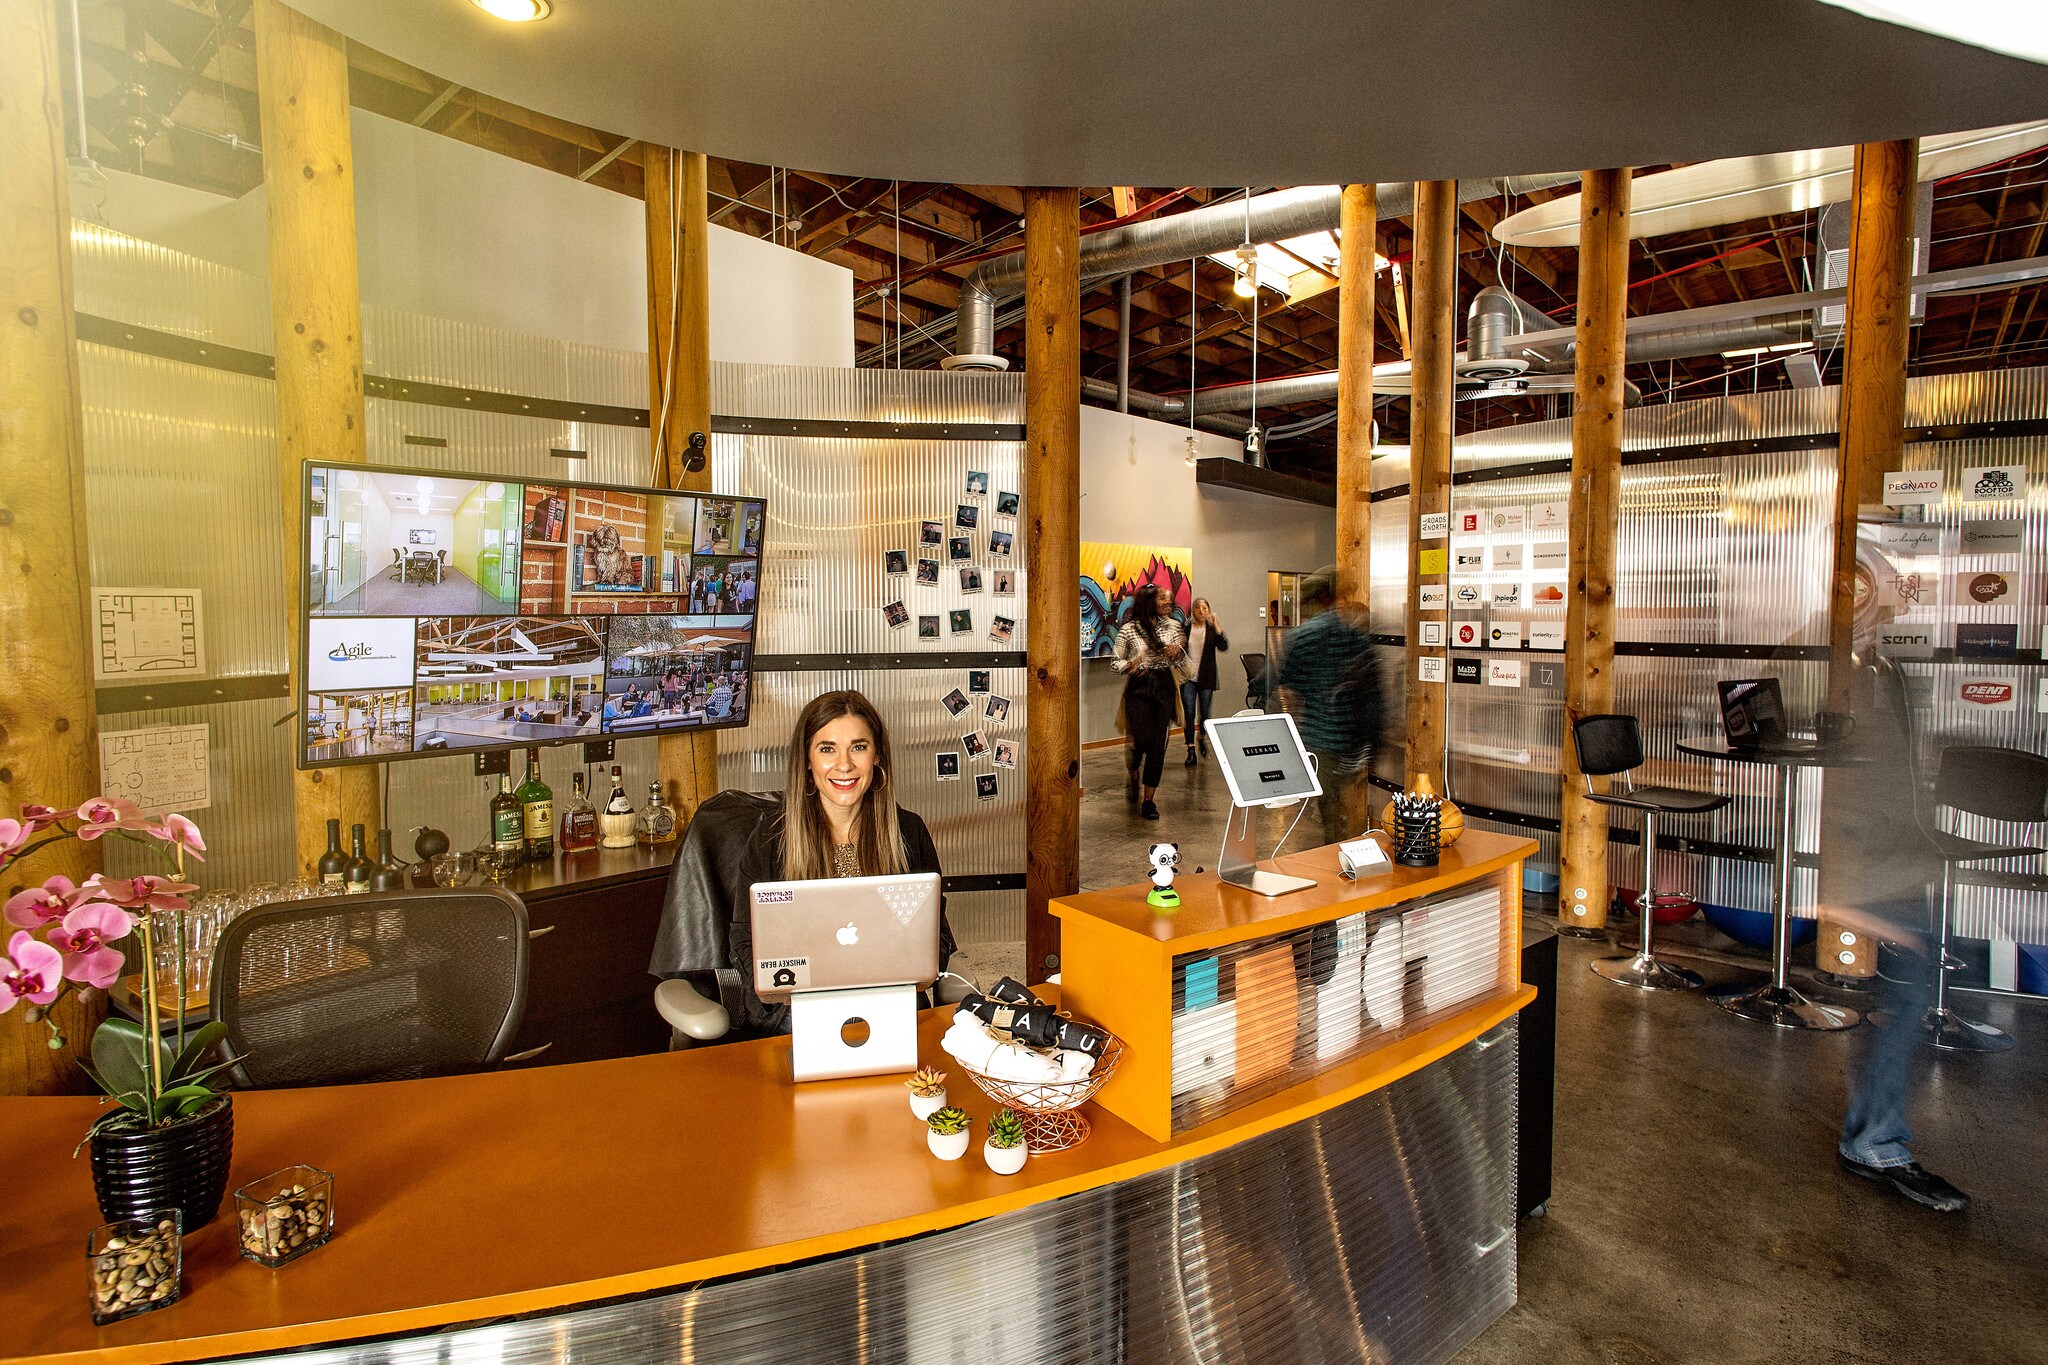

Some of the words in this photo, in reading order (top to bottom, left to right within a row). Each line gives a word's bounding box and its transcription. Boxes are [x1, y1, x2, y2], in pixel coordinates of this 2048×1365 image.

[1888, 480, 1938, 491] PEGNATO
[1974, 487, 2014, 495] ROOFTOP
[1427, 516, 1447, 524] ROADS
[1494, 594, 1518, 603] jhpiego
[334, 642, 373, 661] Agile
[1965, 686, 2009, 695] DENT
[878, 882, 931, 893] TATTOO
[760, 960, 777, 969] BEAR
[778, 958, 807, 968] WHISKEY
